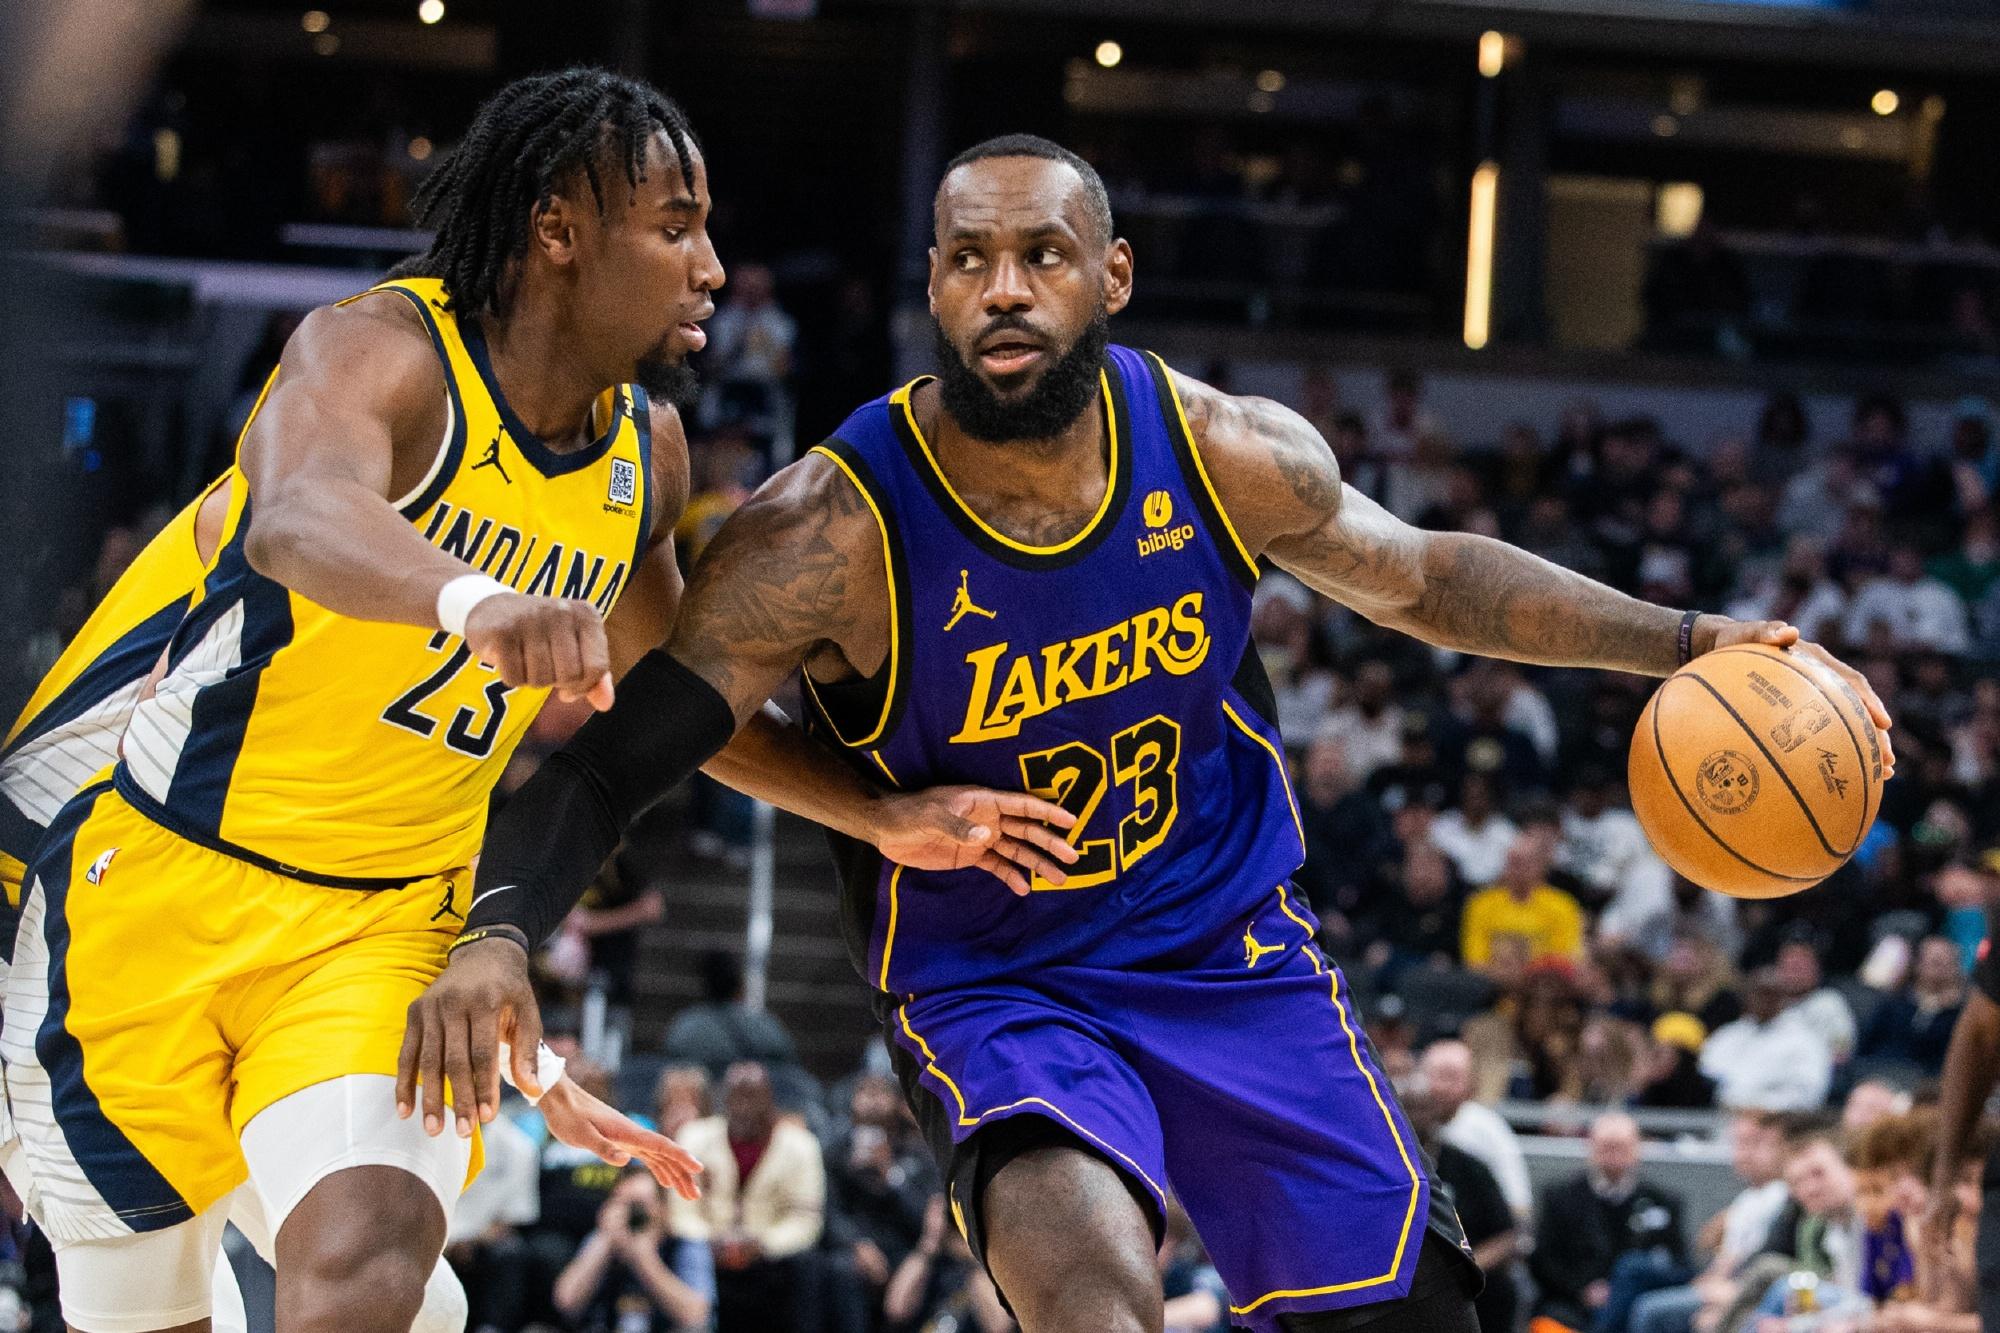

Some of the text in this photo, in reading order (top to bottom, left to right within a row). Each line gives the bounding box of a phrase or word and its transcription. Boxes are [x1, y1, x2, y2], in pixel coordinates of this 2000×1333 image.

[424, 502, 629, 620] INDIANA
[602, 503, 636, 518] spokenote
[1137, 523, 1195, 557] bibigo
[381, 629, 518, 761] 23
[948, 591, 1211, 744] LAKERS
[1018, 713, 1181, 891] 23
